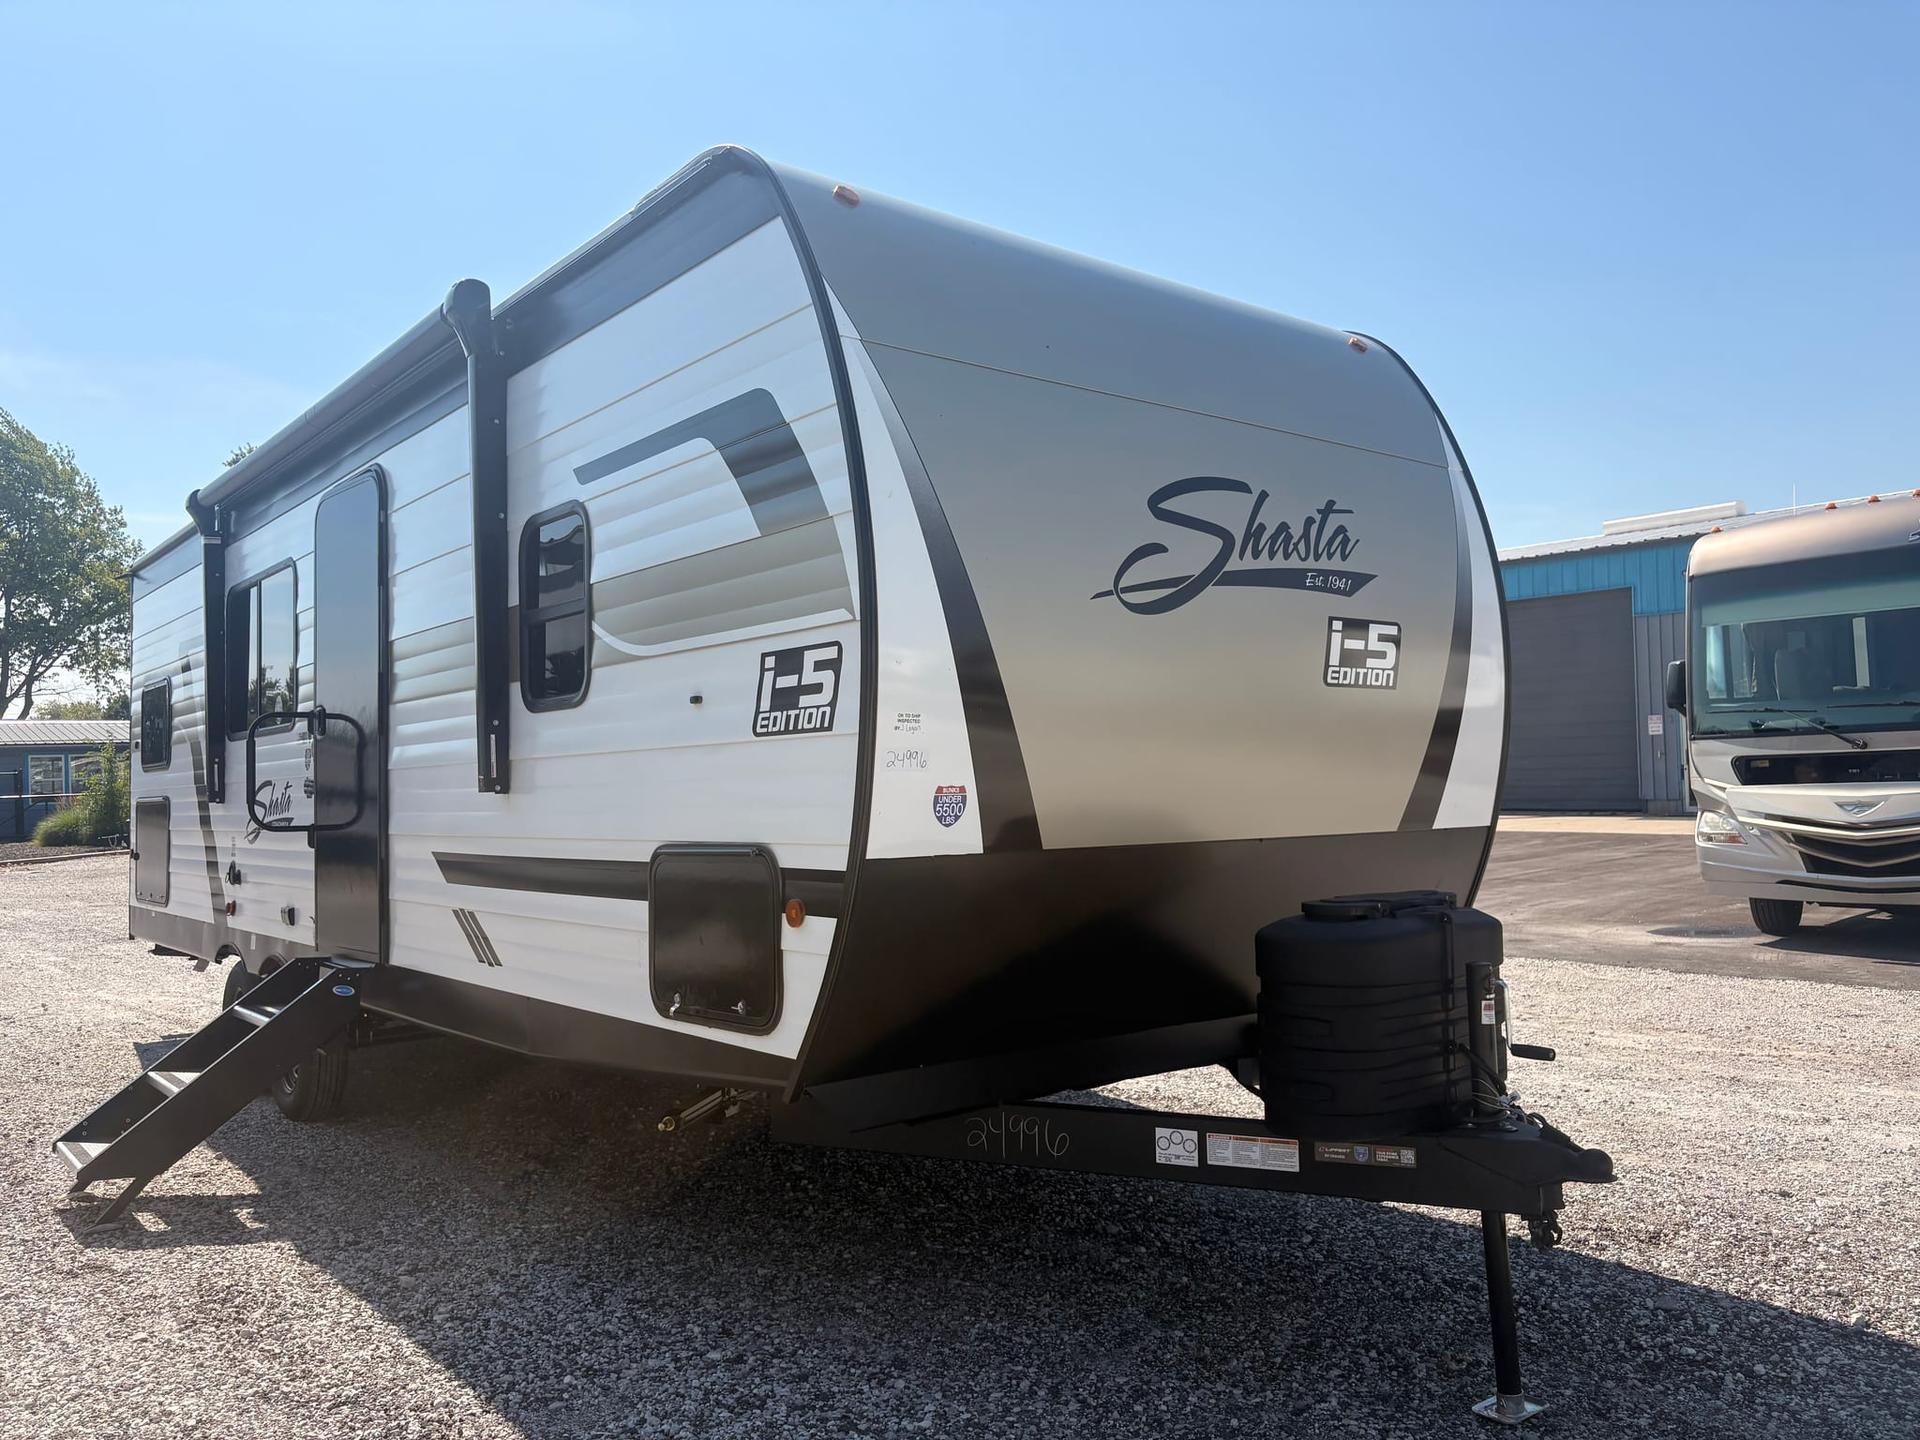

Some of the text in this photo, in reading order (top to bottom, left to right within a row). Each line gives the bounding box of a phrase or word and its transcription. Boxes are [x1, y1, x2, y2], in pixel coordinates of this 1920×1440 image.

[1113, 476, 1360, 615] Shasta
[1305, 572, 1352, 591] Est. 1941
[1329, 620, 1398, 669] i-5
[759, 645, 839, 712] i-5
[1326, 666, 1394, 687] EDITION
[756, 706, 831, 734] EDITION
[886, 749, 927, 769] 24996
[938, 795, 962, 803] UNDER
[935, 803, 964, 817] 5500
[941, 816, 956, 824] LBS
[966, 1111, 1070, 1159] 24996
